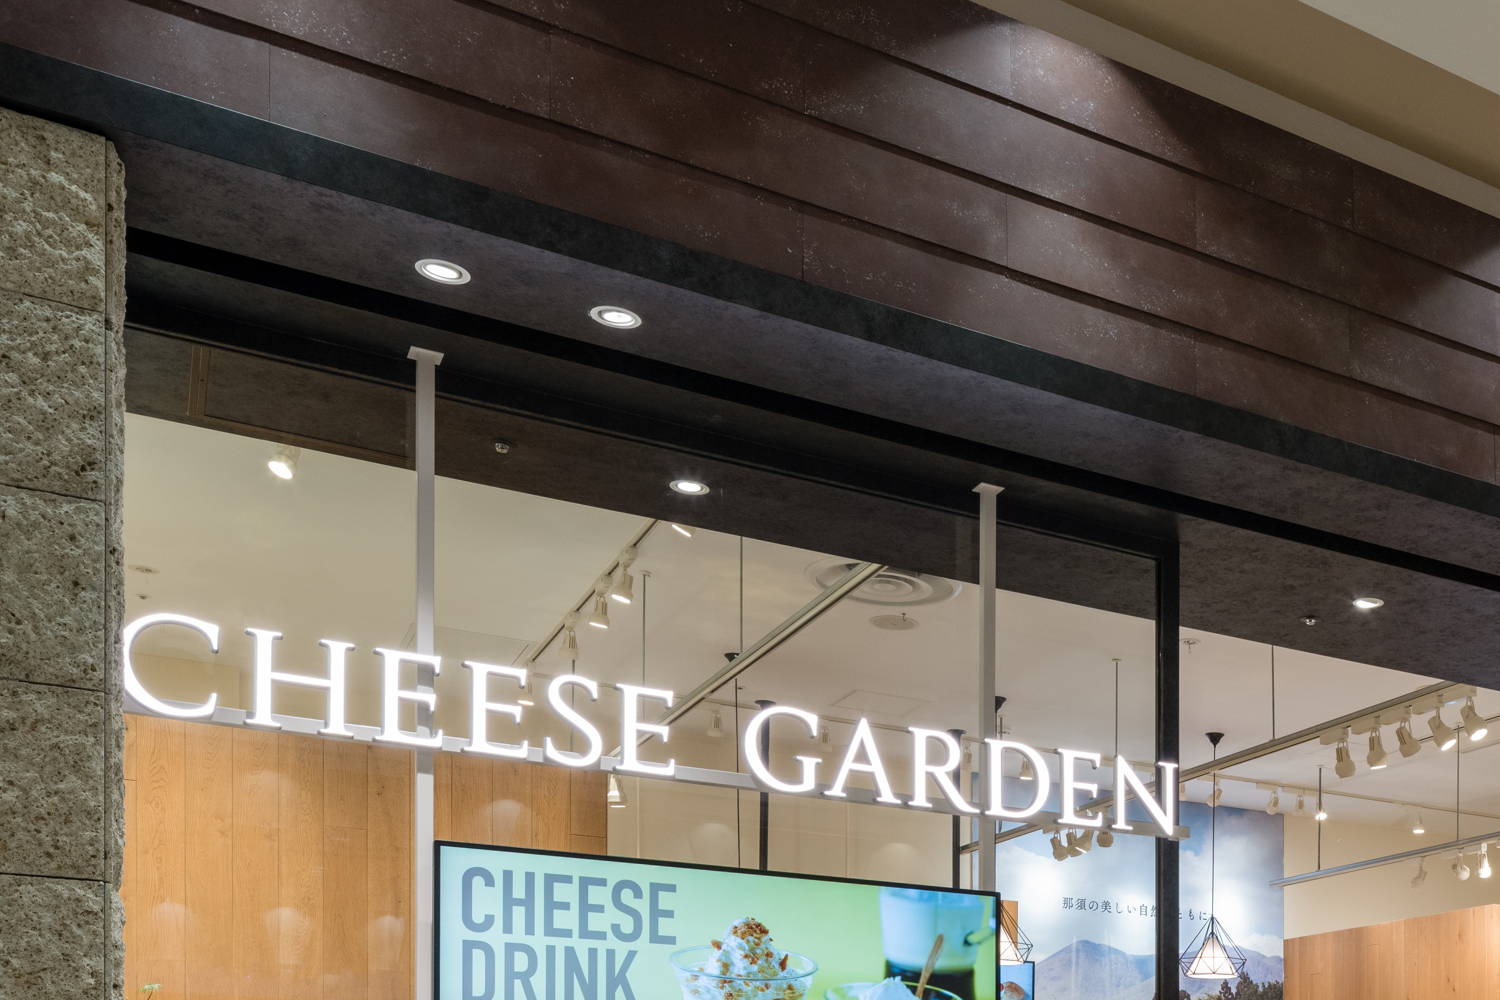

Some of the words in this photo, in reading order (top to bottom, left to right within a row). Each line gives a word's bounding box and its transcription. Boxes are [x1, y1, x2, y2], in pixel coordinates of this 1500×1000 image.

[124, 612, 676, 776] CHEESE
[744, 705, 1180, 839] GARDEN
[460, 866, 678, 946] CHEESE
